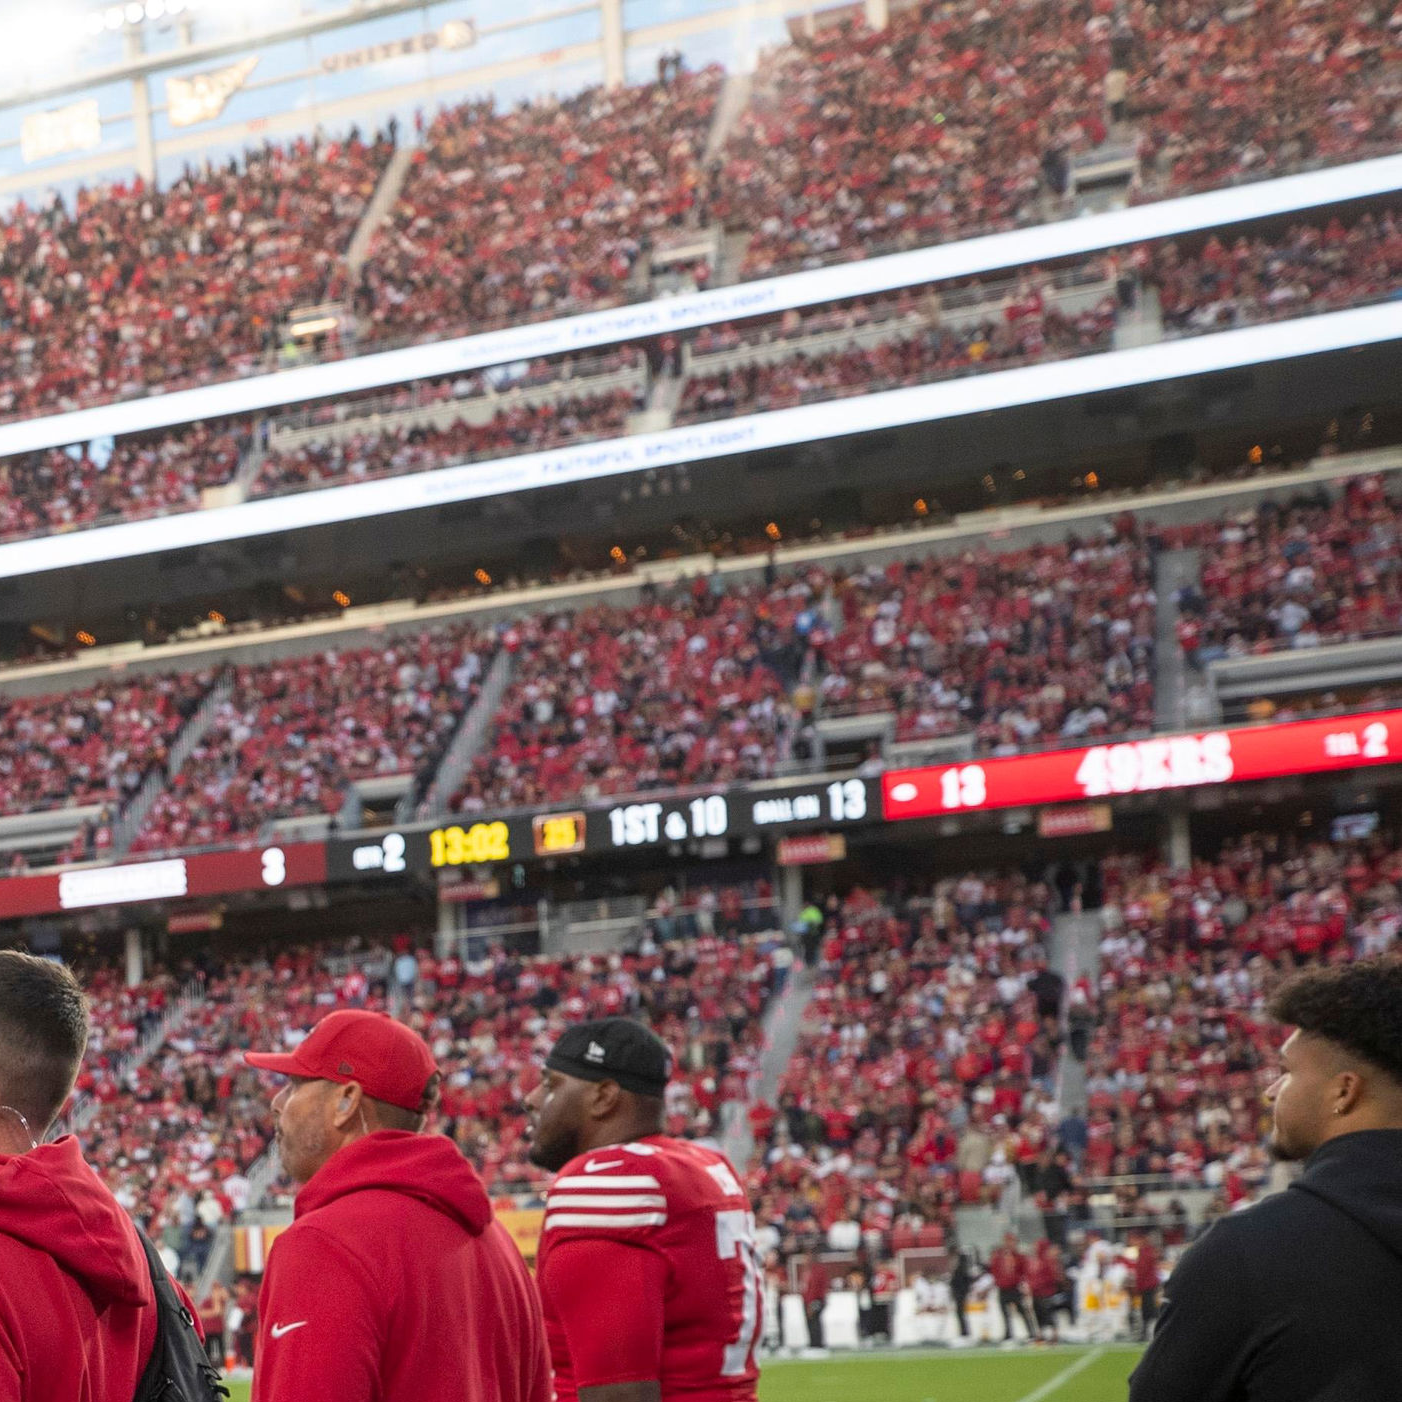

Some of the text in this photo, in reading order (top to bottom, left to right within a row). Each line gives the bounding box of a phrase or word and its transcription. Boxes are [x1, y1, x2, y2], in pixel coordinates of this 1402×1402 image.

[1076, 732, 1234, 797] 49ERS
[1362, 722, 1389, 758] 2
[609, 802, 662, 846] 1ST
[664, 811, 687, 840] &
[689, 795, 728, 837] 10
[827, 779, 867, 822] 13
[940, 765, 987, 808] 13
[262, 848, 285, 885] 3
[382, 833, 406, 872] 2
[429, 821, 509, 867] 13:02
[715, 1208, 767, 1377] 7
